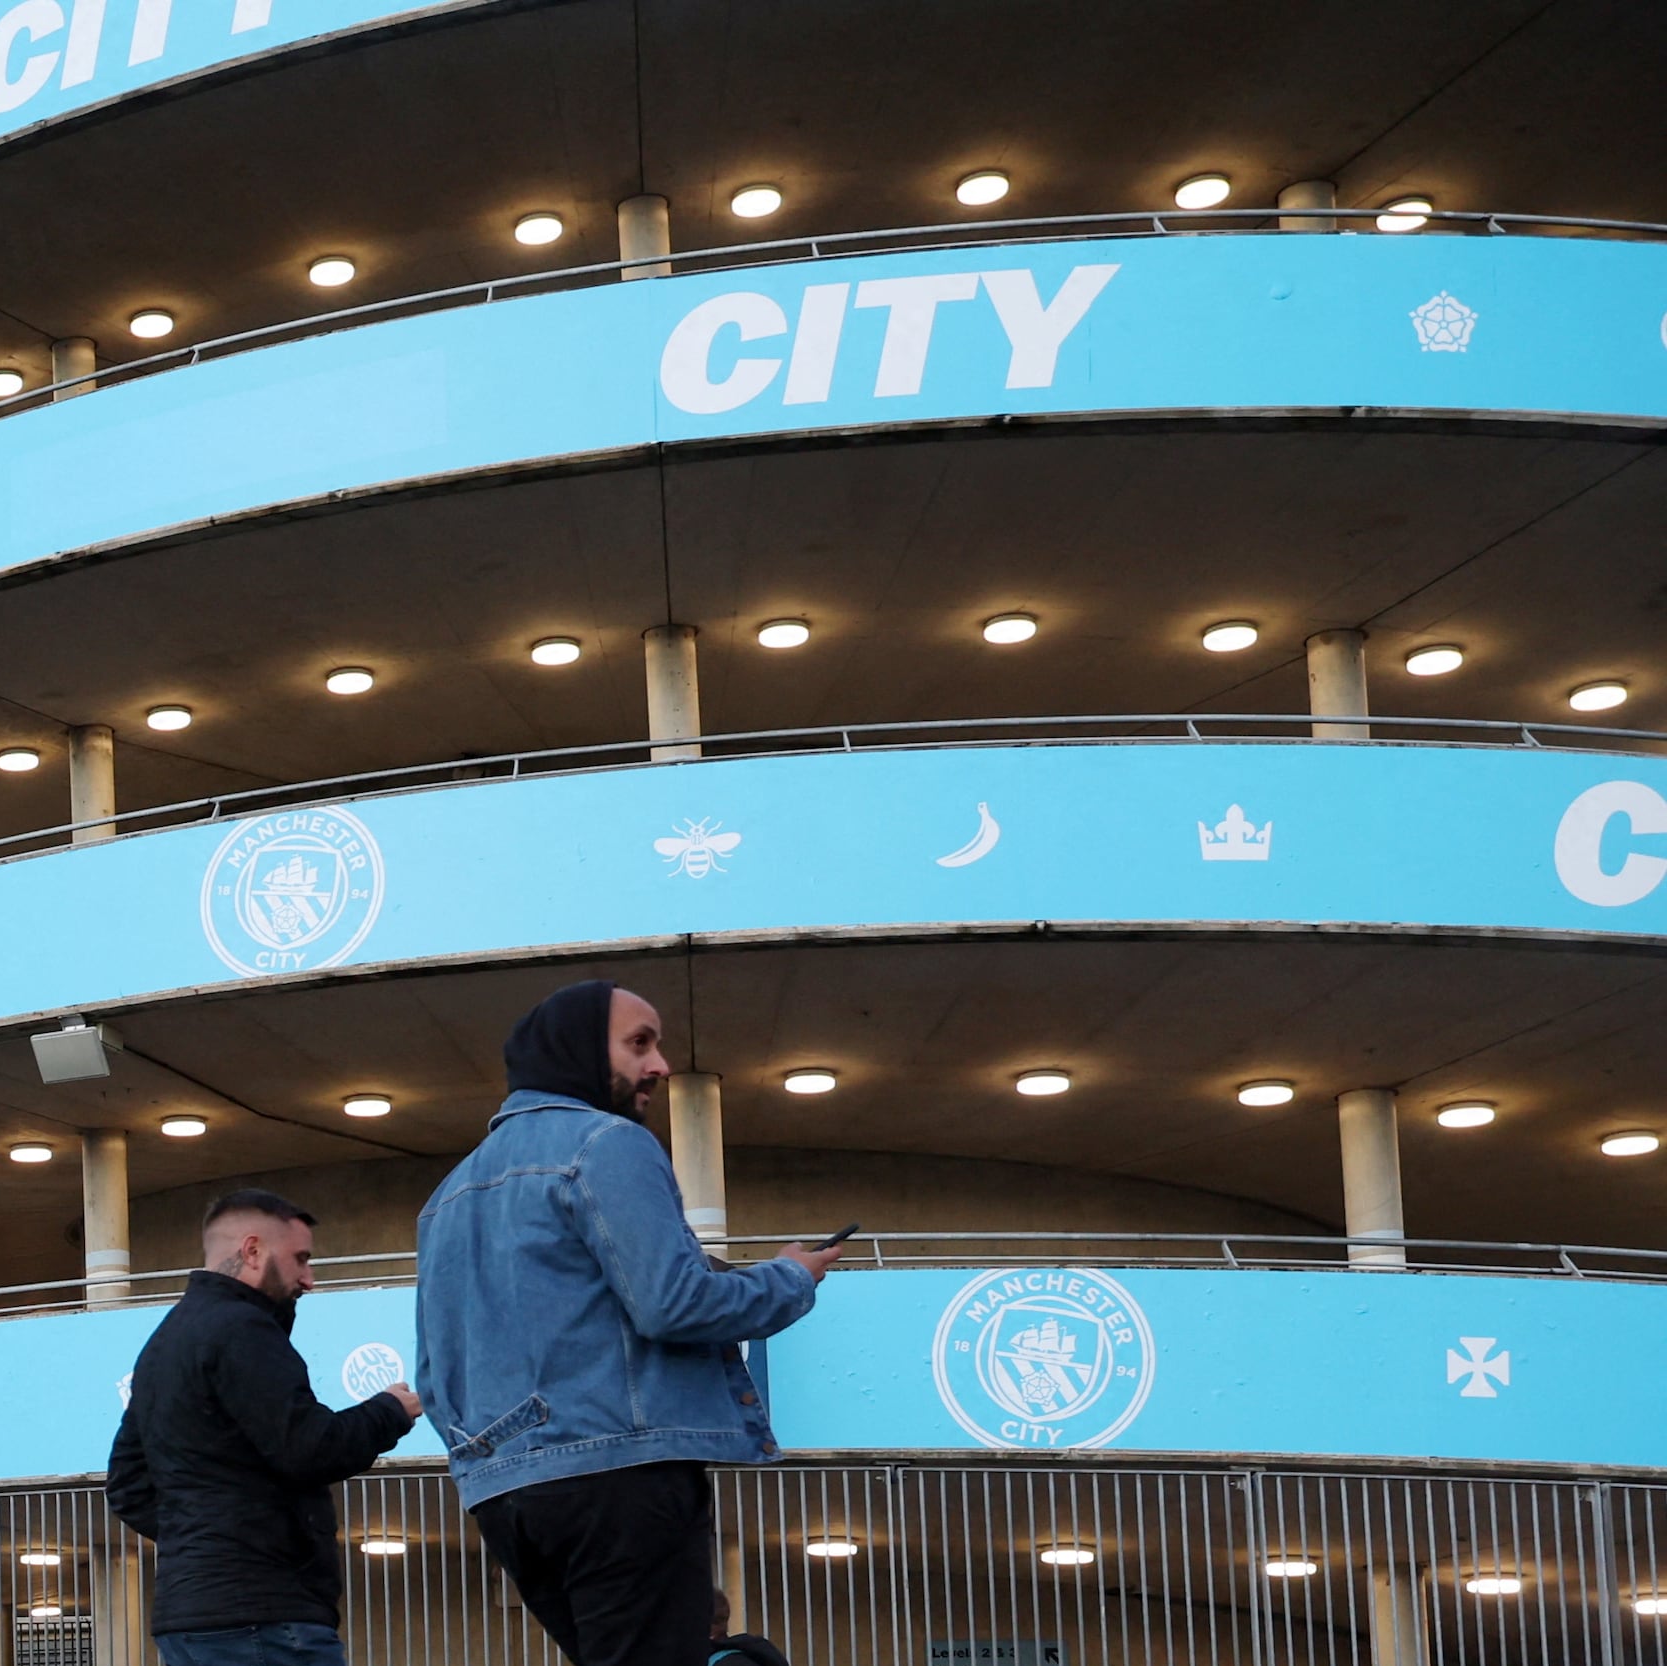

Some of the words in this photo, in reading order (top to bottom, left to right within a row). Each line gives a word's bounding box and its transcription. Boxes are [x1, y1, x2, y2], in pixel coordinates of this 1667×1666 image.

[658, 263, 1120, 414] CITY
[228, 813, 365, 874] MANCHESTER
[217, 884, 231, 896] 18
[351, 888, 369, 899] 94
[255, 951, 308, 970] CITY
[966, 1273, 1134, 1347] MANCHESTER
[953, 1338, 970, 1352] 18
[1115, 1365, 1136, 1380] 94
[1000, 1419, 1064, 1446] CITY
[932, 1647, 976, 1658] Leel
